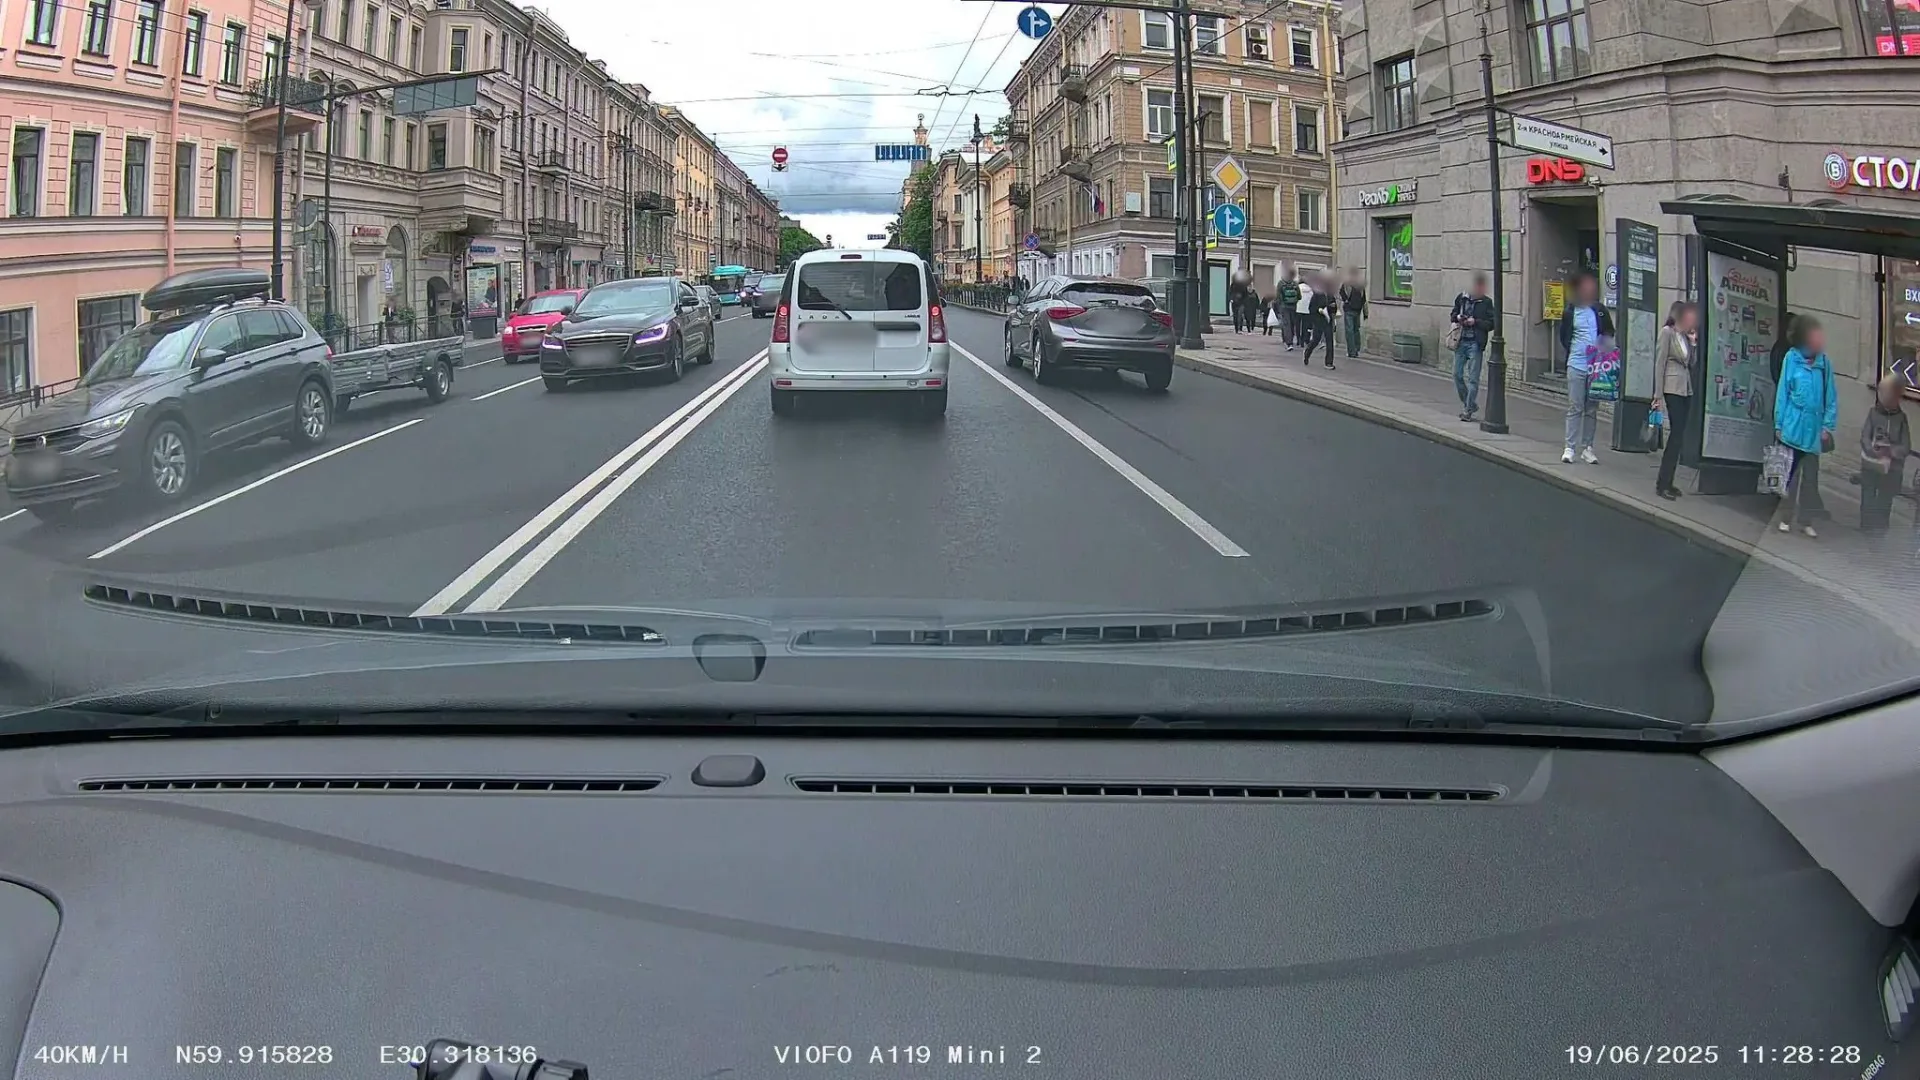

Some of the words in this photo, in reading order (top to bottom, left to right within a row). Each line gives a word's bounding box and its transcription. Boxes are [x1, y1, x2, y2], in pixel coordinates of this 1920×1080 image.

[1528, 125, 1597, 147] КРАСНОАРМЕЙСКАЯ
[1549, 141, 1568, 150] улица
[1527, 158, 1585, 184] DNS
[1588, 360, 1620, 375] OZON
[1861, 1055, 1885, 1080] AIRBAG
